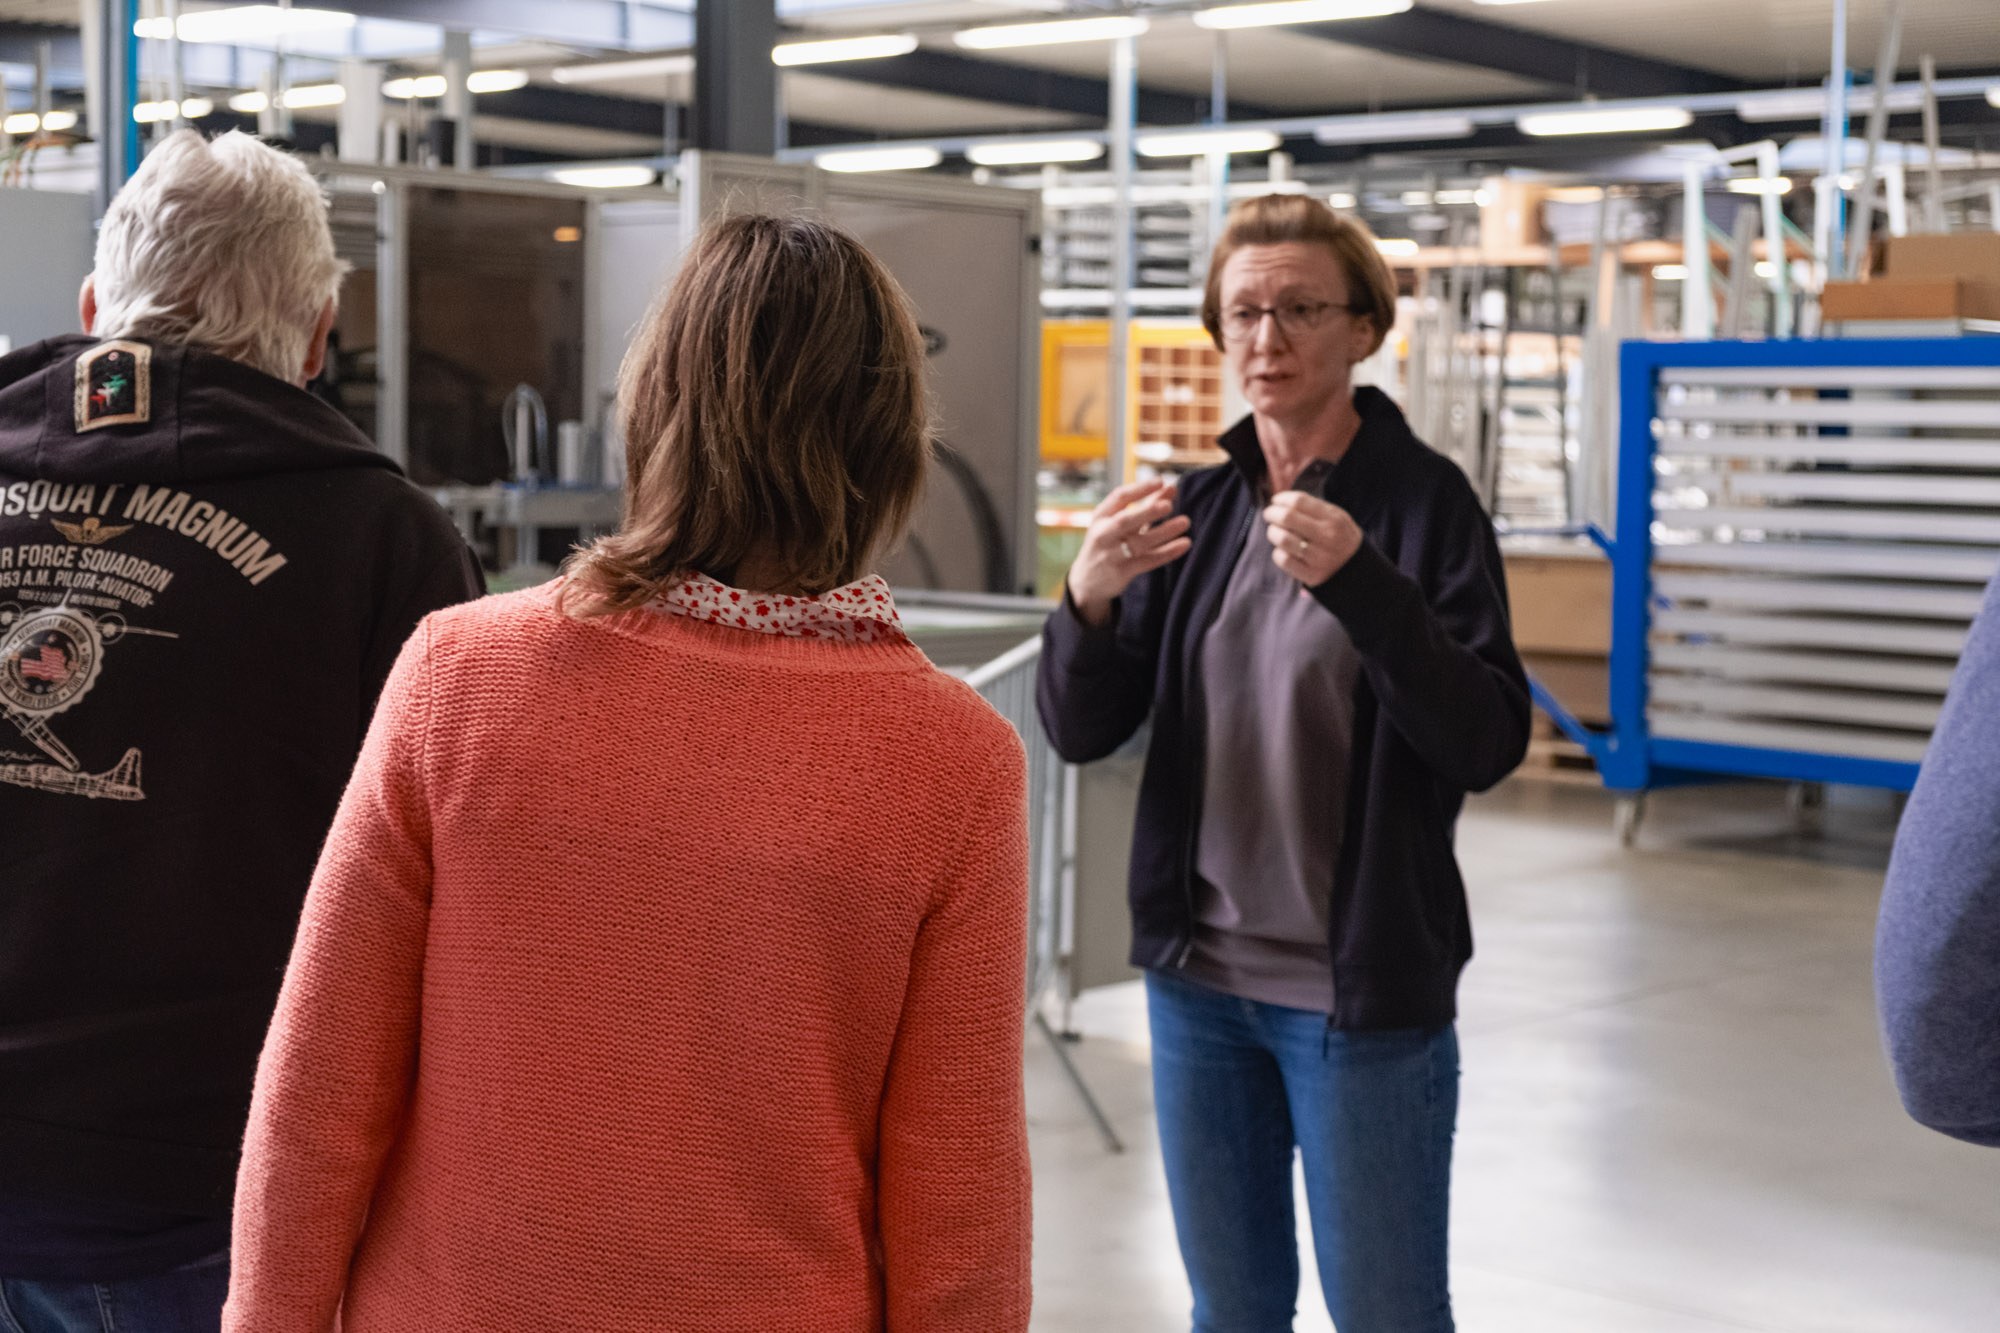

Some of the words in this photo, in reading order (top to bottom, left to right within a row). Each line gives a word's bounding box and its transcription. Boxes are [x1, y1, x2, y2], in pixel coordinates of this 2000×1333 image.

[17, 545, 77, 568] FORCE
[78, 548, 174, 592] SQUADRON
[122, 484, 287, 586] MAGNUM
